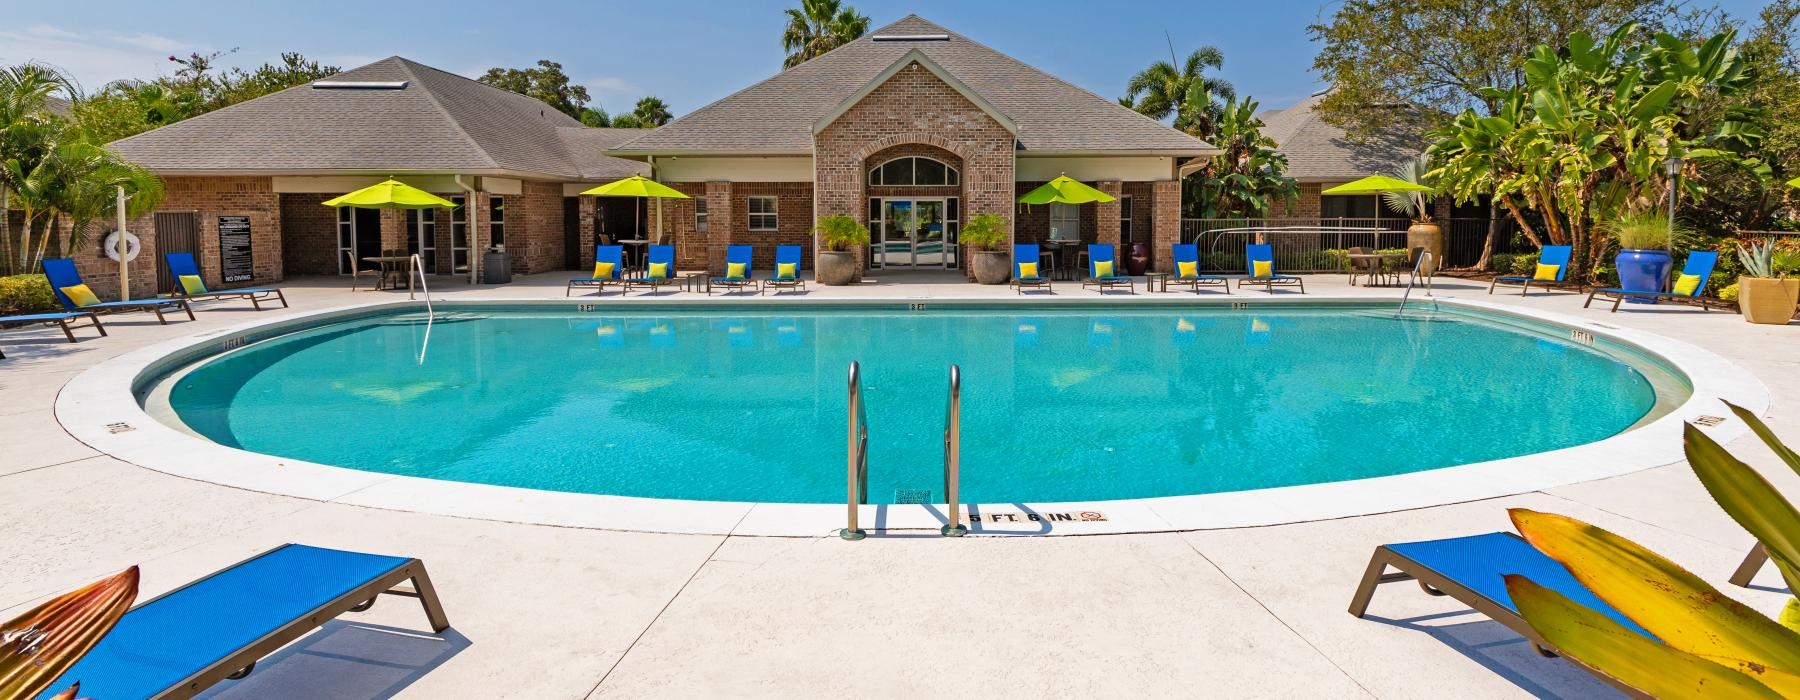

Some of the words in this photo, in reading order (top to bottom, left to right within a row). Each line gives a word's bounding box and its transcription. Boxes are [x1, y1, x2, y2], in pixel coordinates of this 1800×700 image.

[968, 514, 981, 522] 5
[991, 514, 1018, 522] FT.
[1027, 513, 1041, 522] 6
[1048, 513, 1077, 522] IN.
